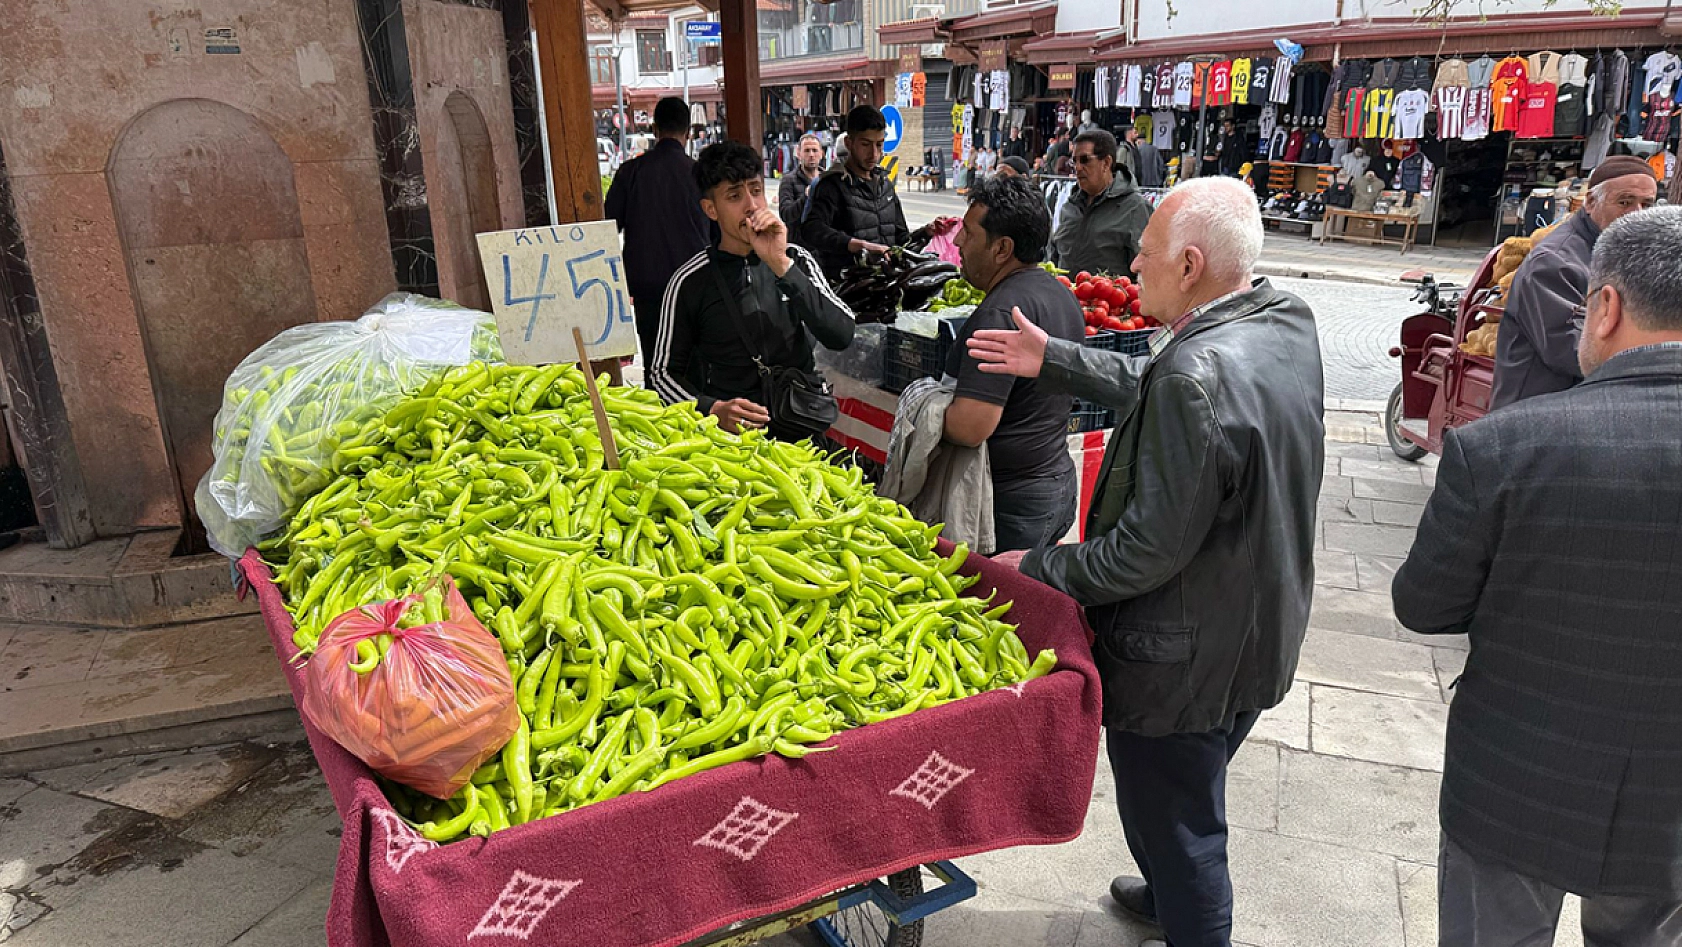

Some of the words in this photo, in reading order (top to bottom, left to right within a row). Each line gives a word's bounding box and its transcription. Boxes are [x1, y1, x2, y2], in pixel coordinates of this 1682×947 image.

[1177, 75, 1190, 92] 23
[1214, 72, 1227, 92] 21
[1235, 72, 1247, 88] 19
[1252, 72, 1267, 88] 23
[1159, 125, 1168, 138] 9
[502, 249, 613, 346] 45
